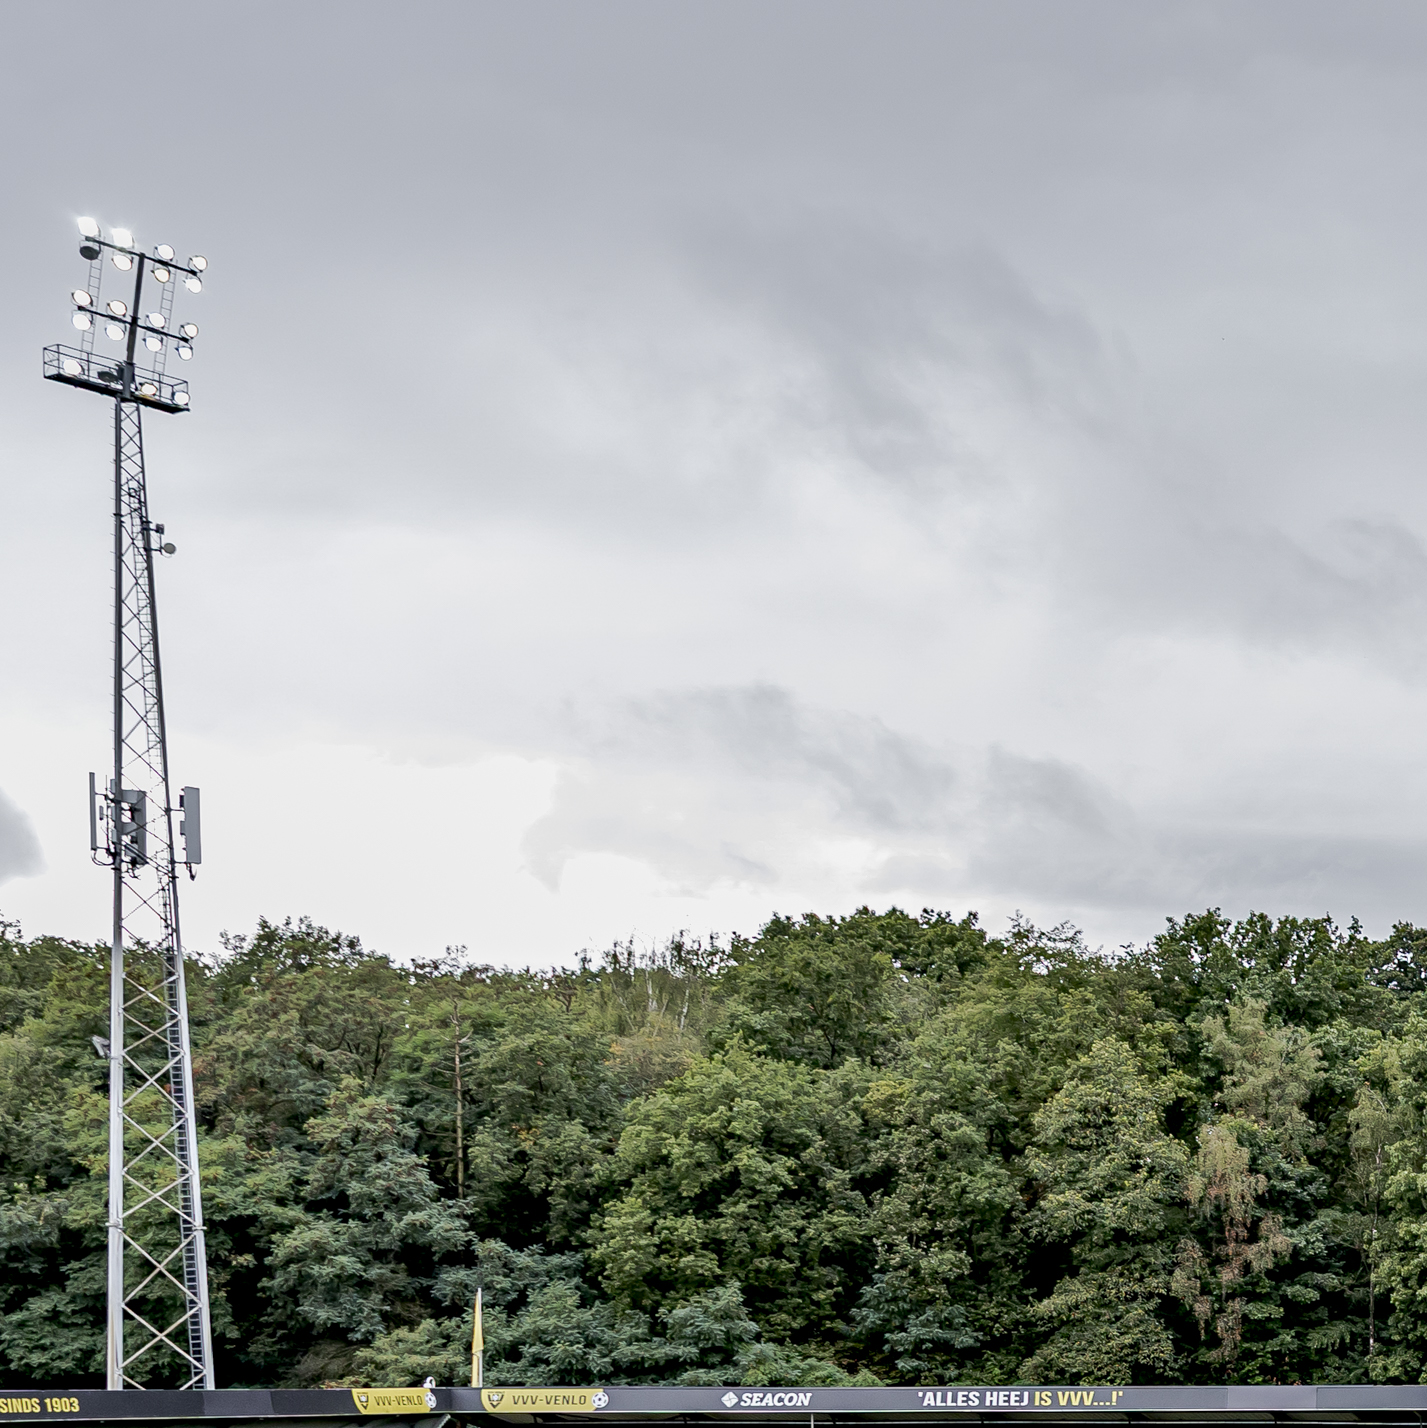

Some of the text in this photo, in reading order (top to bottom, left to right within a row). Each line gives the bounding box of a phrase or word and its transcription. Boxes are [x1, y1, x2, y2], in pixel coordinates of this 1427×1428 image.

[0, 1397, 80, 1413] SINDS 1903
[374, 1395, 423, 1406] VVV-VENLO
[512, 1395, 587, 1405] VVV-VENLO
[740, 1393, 812, 1406] SEACON
[985, 1391, 1029, 1406] HEEJ
[1034, 1391, 1052, 1406] IS
